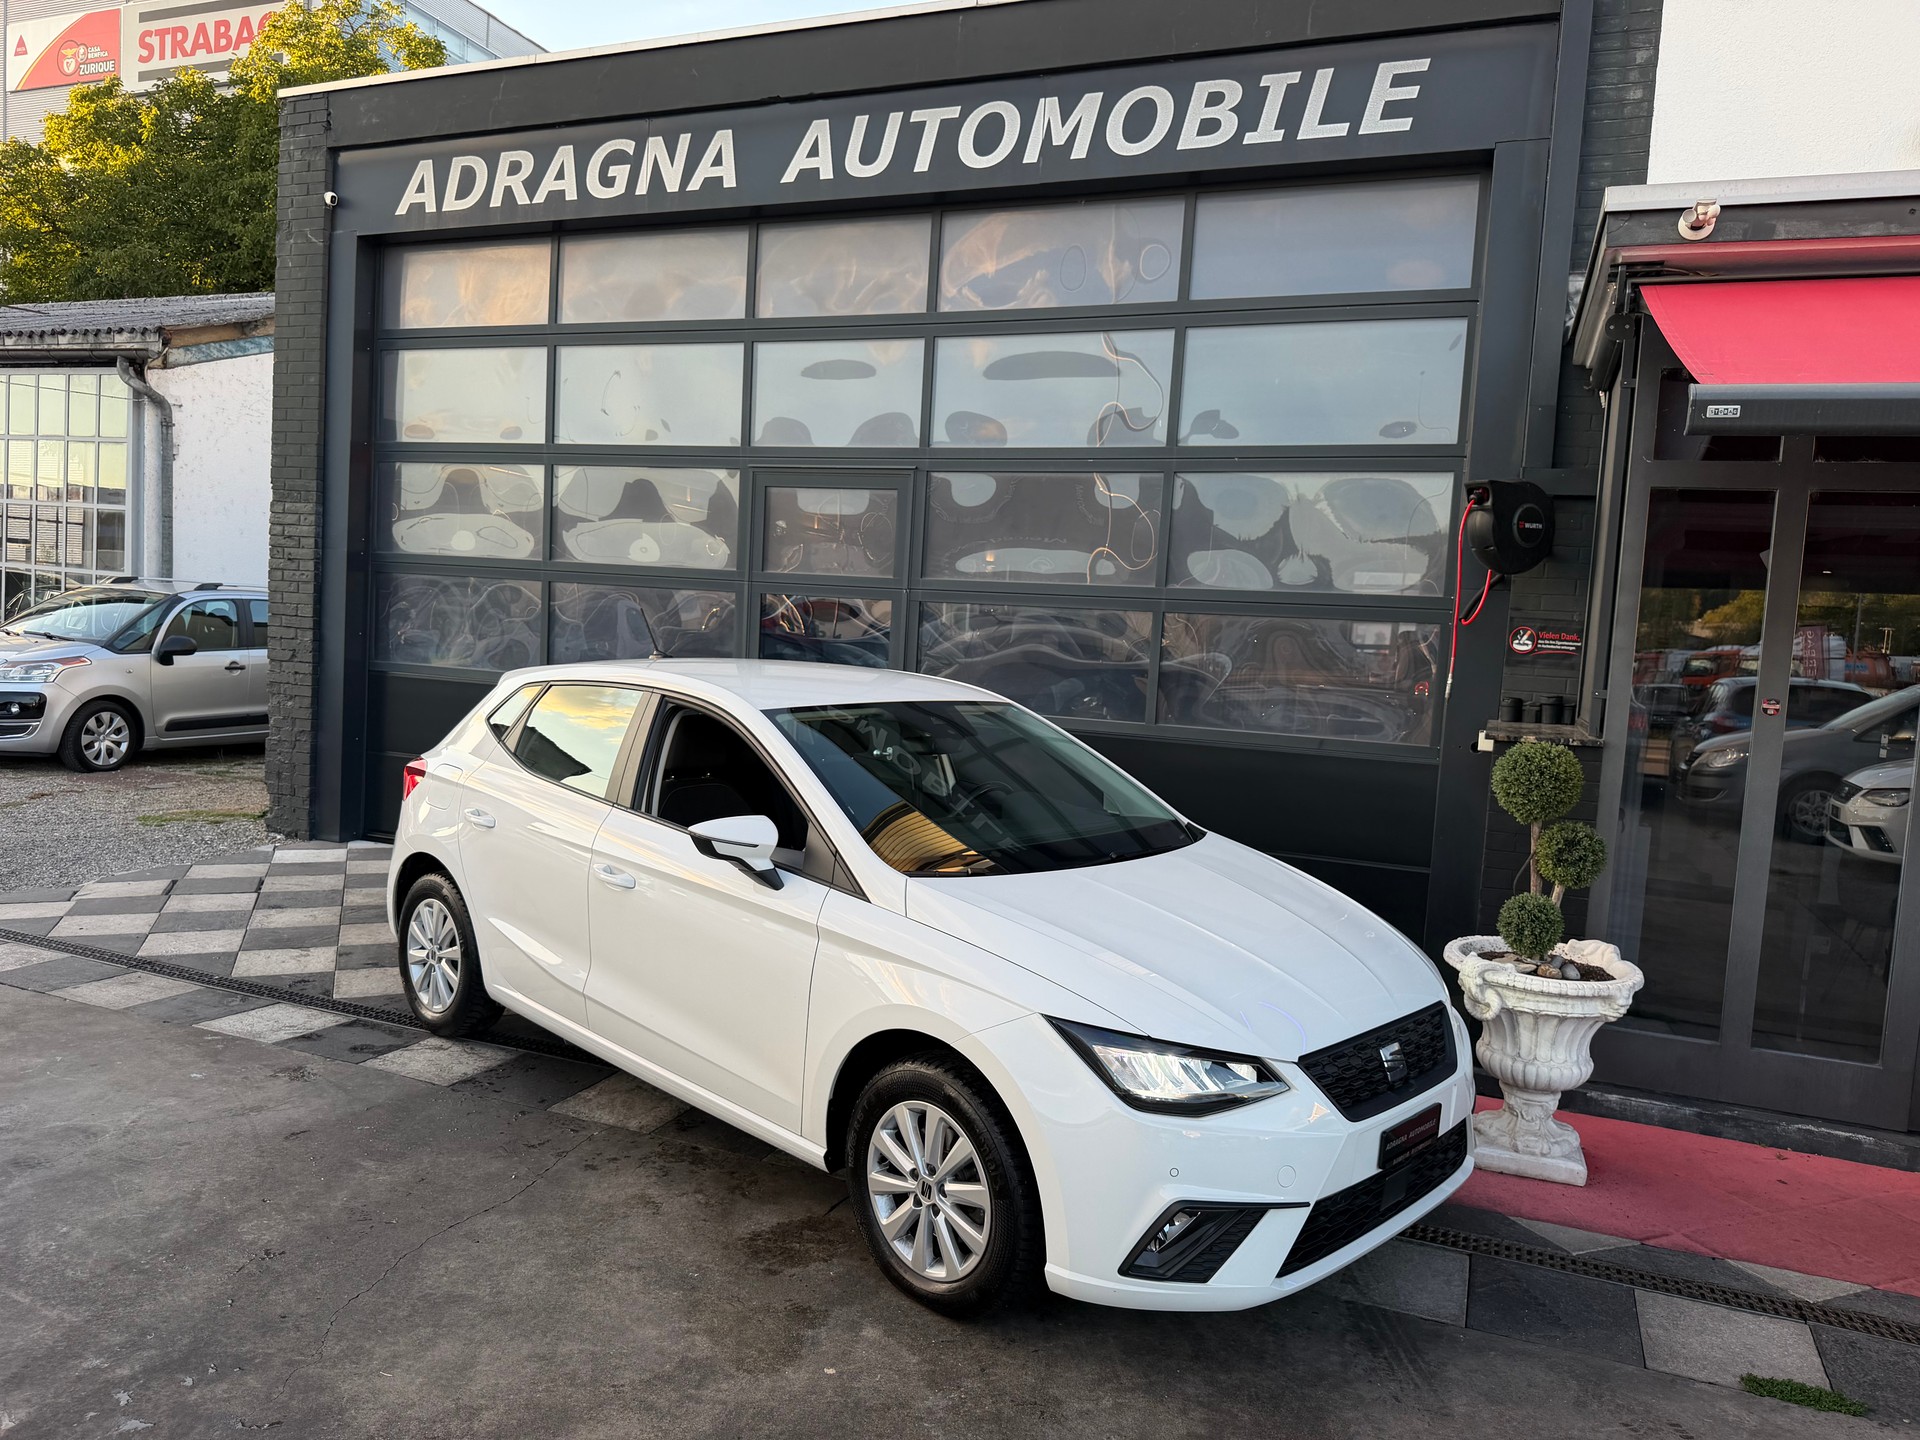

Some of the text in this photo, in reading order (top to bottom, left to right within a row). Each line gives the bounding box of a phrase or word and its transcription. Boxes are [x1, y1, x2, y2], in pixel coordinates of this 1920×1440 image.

[87, 45, 101, 53] CASA
[87, 50, 109, 59] BENFICA
[79, 60, 115, 75] ZURIQUE
[395, 58, 1431, 215] ADRAGNA AUTOMOBILE
[1538, 631, 1560, 640] Vielen
